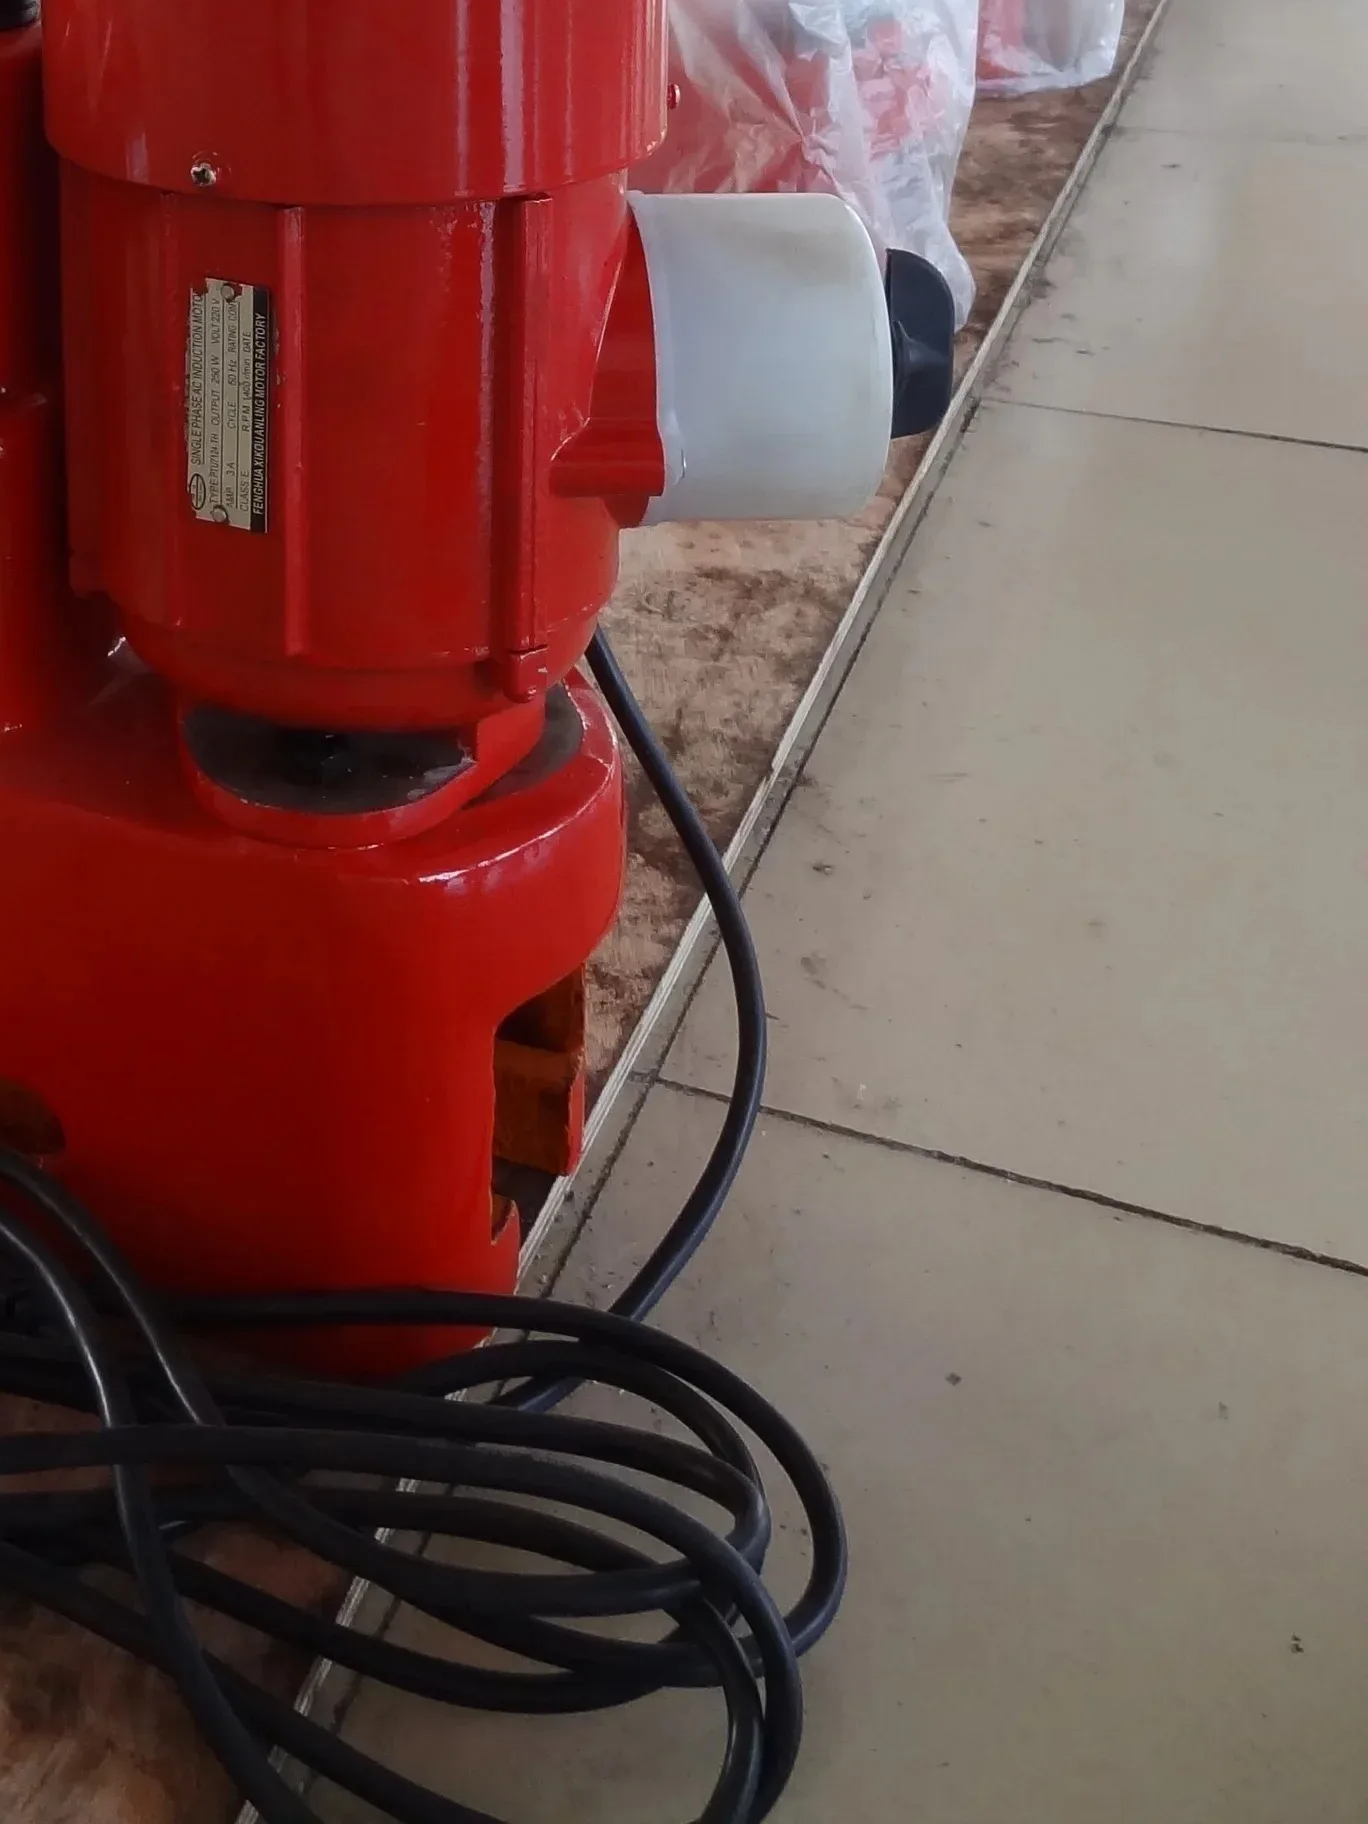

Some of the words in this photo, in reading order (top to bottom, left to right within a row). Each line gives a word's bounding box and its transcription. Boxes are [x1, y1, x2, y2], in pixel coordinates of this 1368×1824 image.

[192, 293, 203, 324] MOTO
[211, 307, 220, 322] 220
[228, 300, 236, 321] CON
[211, 324, 220, 344] VOLT
[228, 325, 236, 353] RATING
[243, 331, 251, 353] DATE
[255, 313, 266, 360] FACTORY
[192, 326, 203, 379] INDUCTION
[211, 354, 219, 365] W
[228, 359, 236, 372] Hz
[192, 382, 202, 395] AC
[254, 362, 265, 398] MOTOR
[191, 396, 202, 428] PHASE
[210, 389, 220, 426] OUTPUT
[227, 401, 236, 429] CYCLE
[191, 430, 202, 465] SINGLE
[240, 469, 249, 478] E
[209, 479, 219, 504] TYPE
[240, 481, 249, 512] CLASS
[253, 469, 263, 515] FENGHUA
